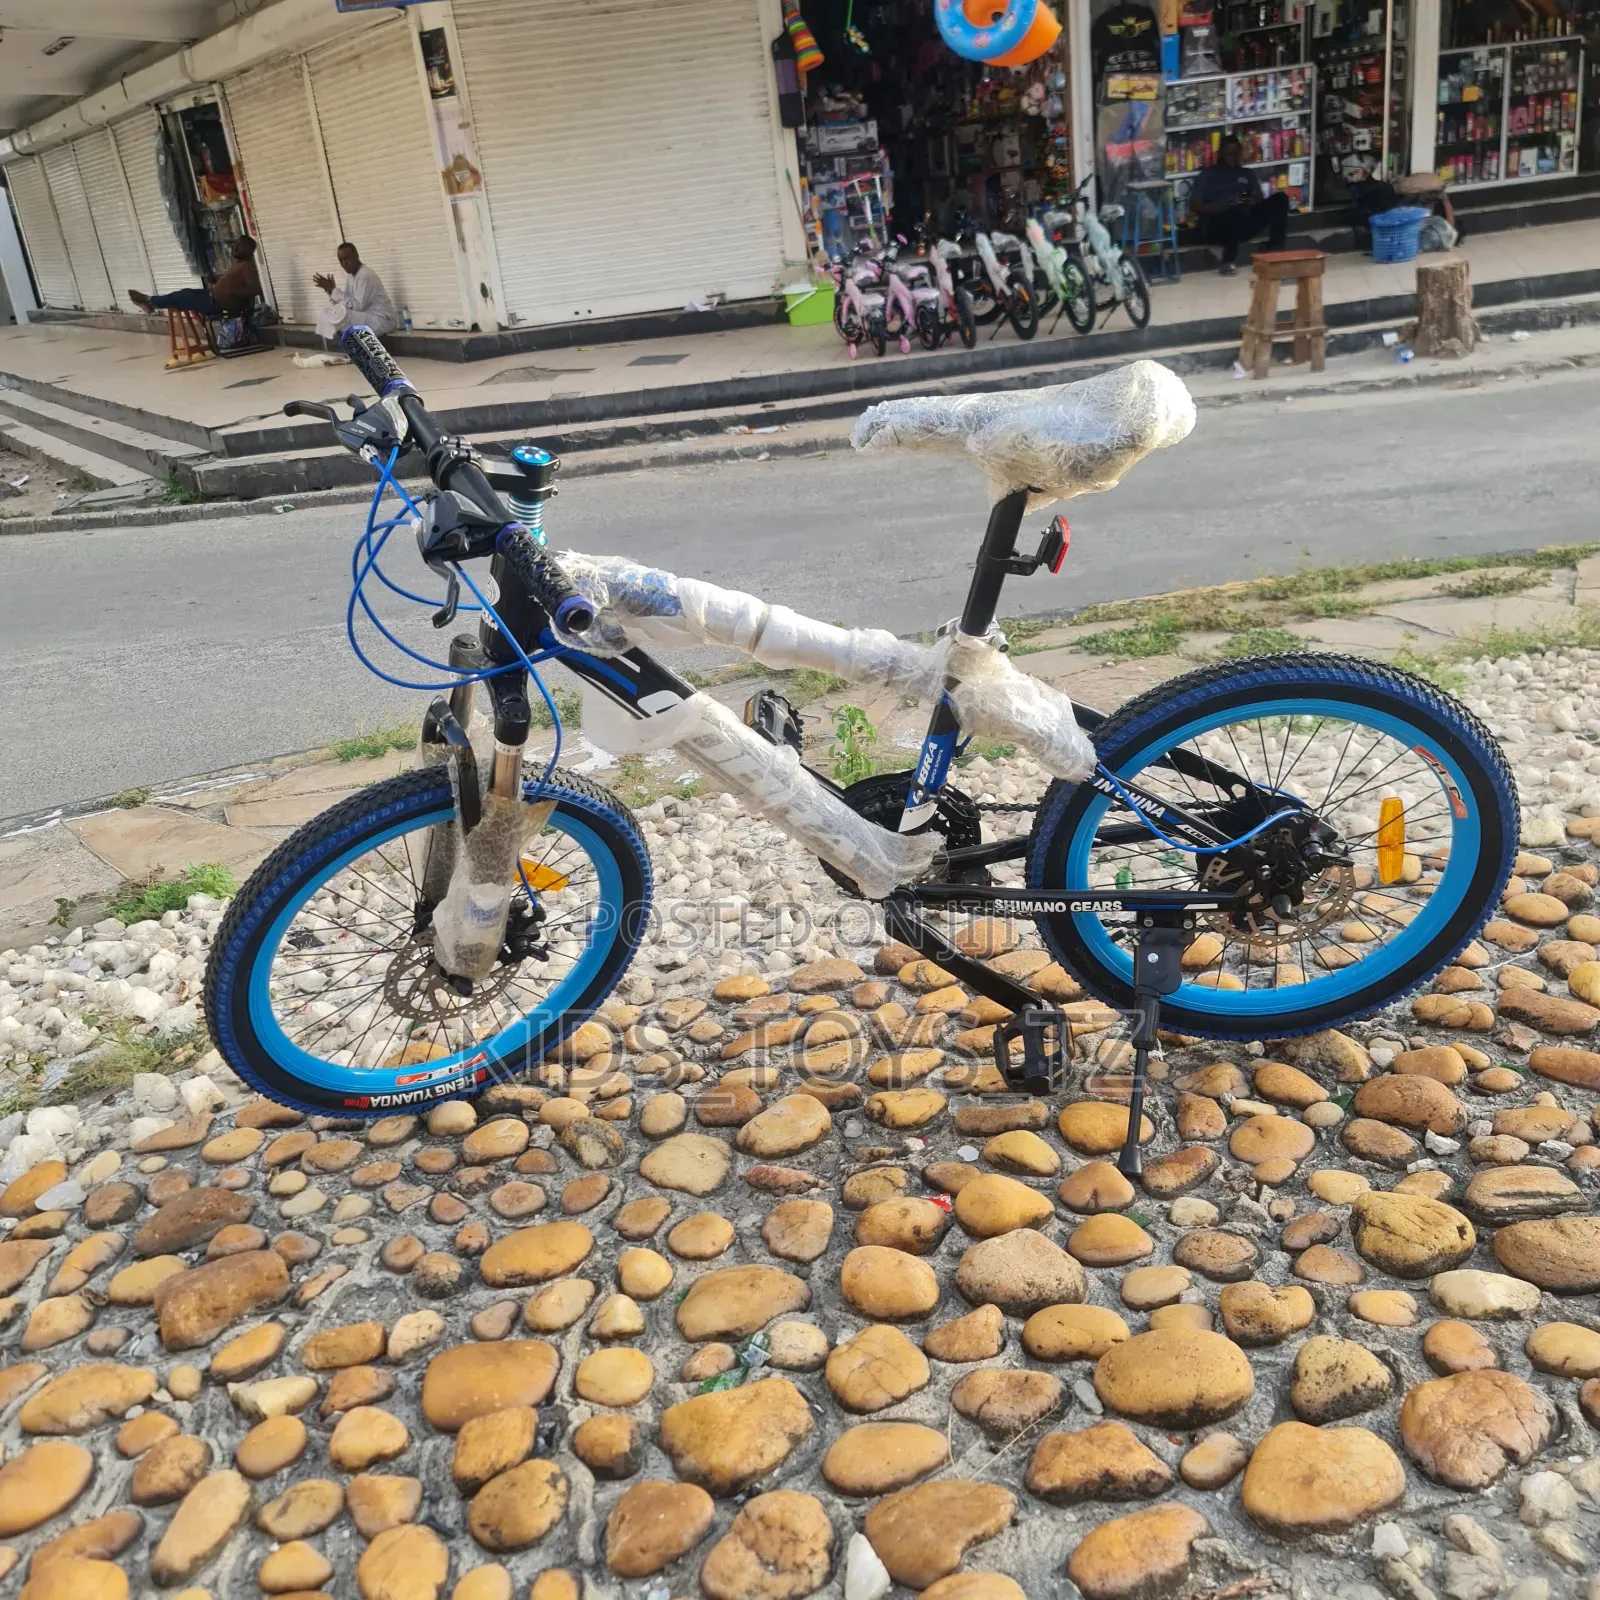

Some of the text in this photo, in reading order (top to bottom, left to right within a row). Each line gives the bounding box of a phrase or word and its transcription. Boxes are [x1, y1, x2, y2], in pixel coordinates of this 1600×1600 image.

[1093, 777, 1115, 793] IN
[994, 899, 1123, 912] SHIMANO GEARS
[435, 1073, 477, 1096] HENG
[370, 1087, 434, 1108] YUANDA
